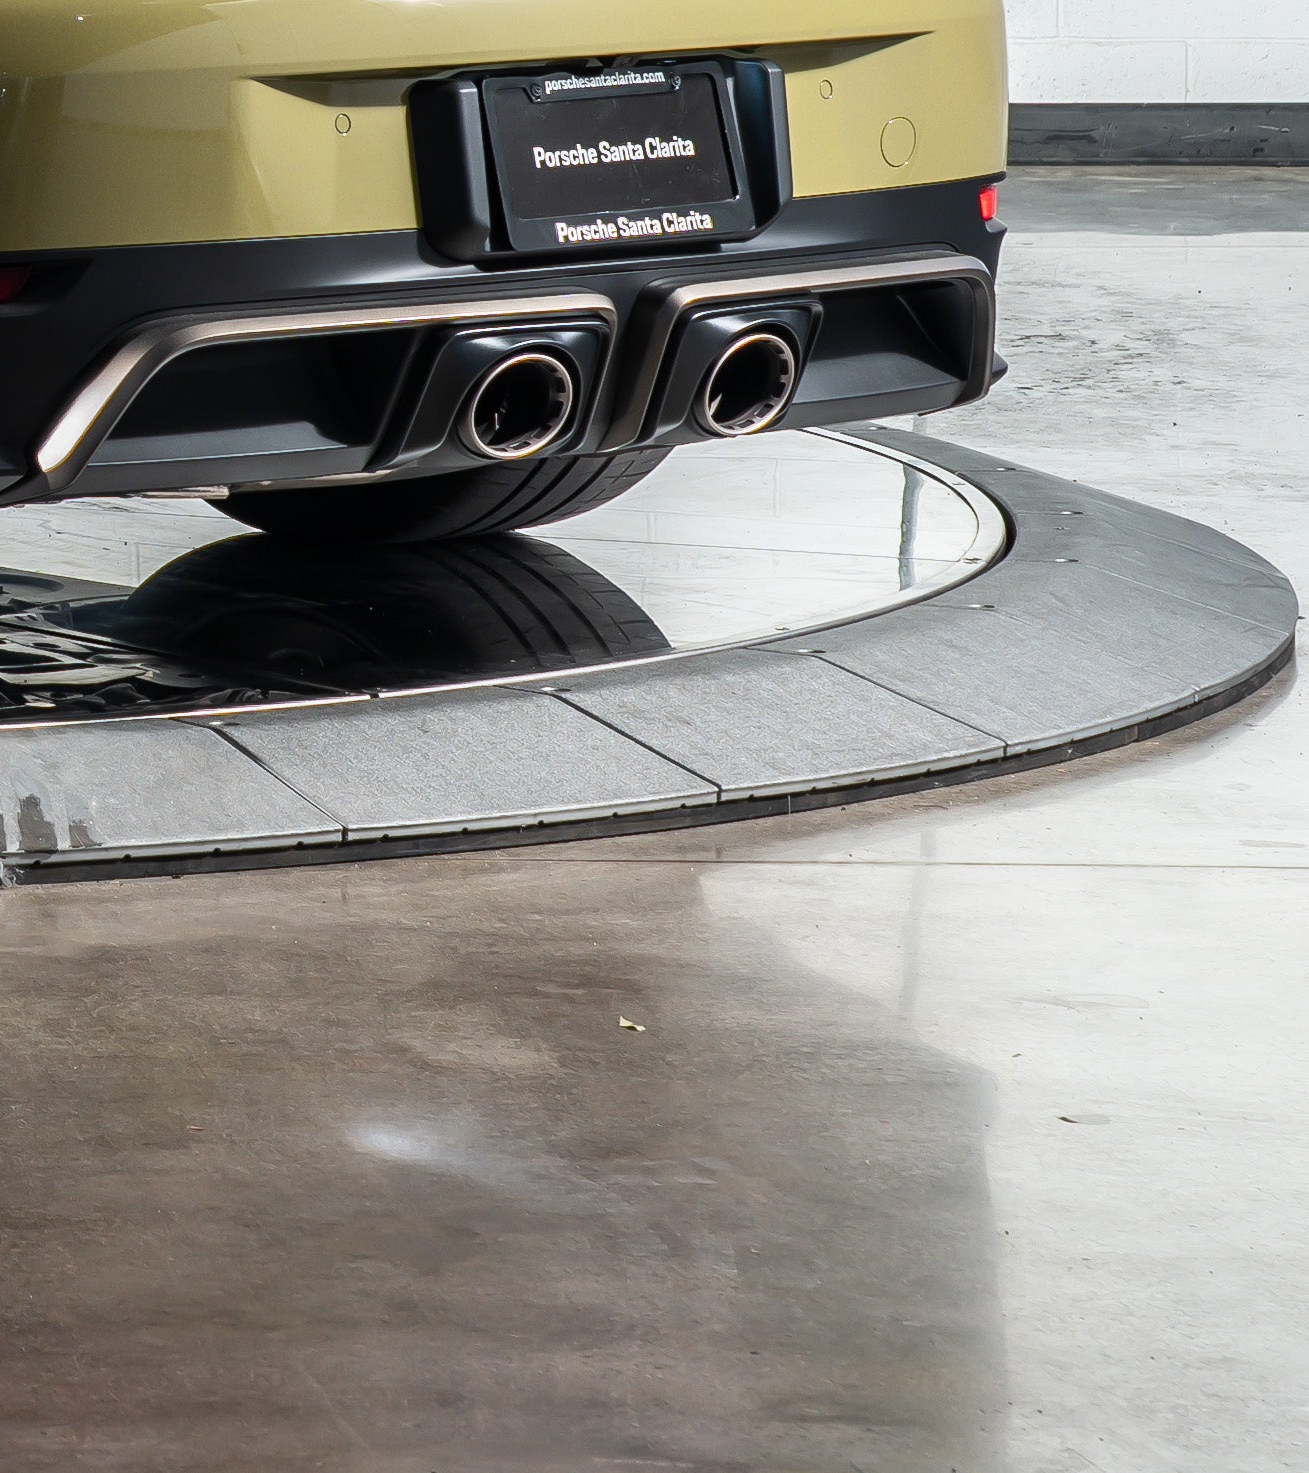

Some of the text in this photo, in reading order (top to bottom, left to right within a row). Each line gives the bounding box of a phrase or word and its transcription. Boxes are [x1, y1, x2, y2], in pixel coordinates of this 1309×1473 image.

[544, 71, 666, 94] porschesantaclarita.com
[532, 136, 696, 169] Porsche Santa Clarita
[555, 211, 714, 244] Porsche Santa Clarita
